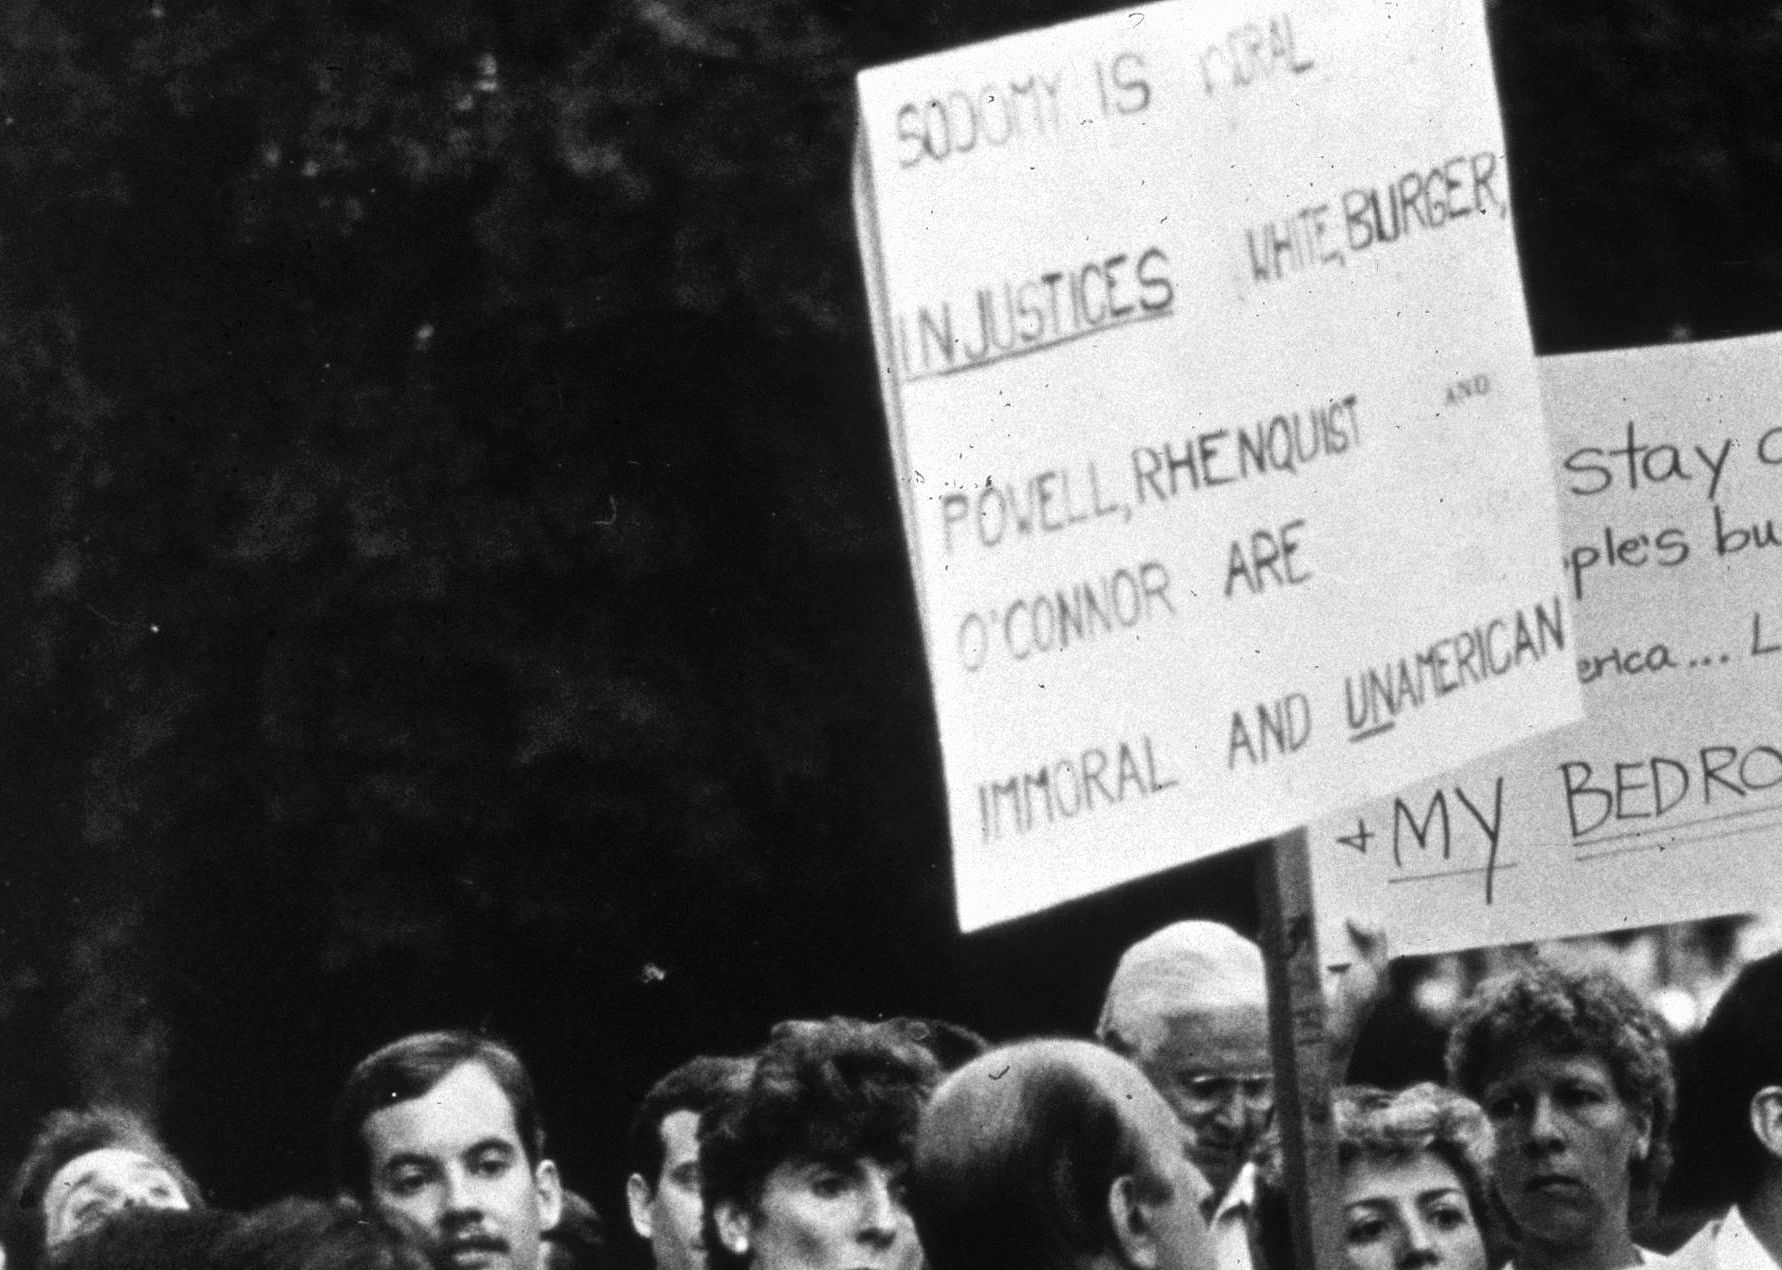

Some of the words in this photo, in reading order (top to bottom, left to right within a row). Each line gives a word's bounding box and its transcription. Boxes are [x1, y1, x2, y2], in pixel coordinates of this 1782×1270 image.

[1096, 52, 1152, 119] IS
[899, 246, 1174, 373] INJUSTICES
[1444, 374, 1490, 408] AND
[1563, 421, 1731, 498] stay
[958, 561, 1178, 673] O'CONNOR
[1223, 519, 1312, 598] ARE
[976, 735, 1179, 846] IMMORAL
[1226, 692, 1312, 770] AND
[1344, 597, 1565, 731] UNAMERICAN
[1391, 777, 1503, 904] MY
